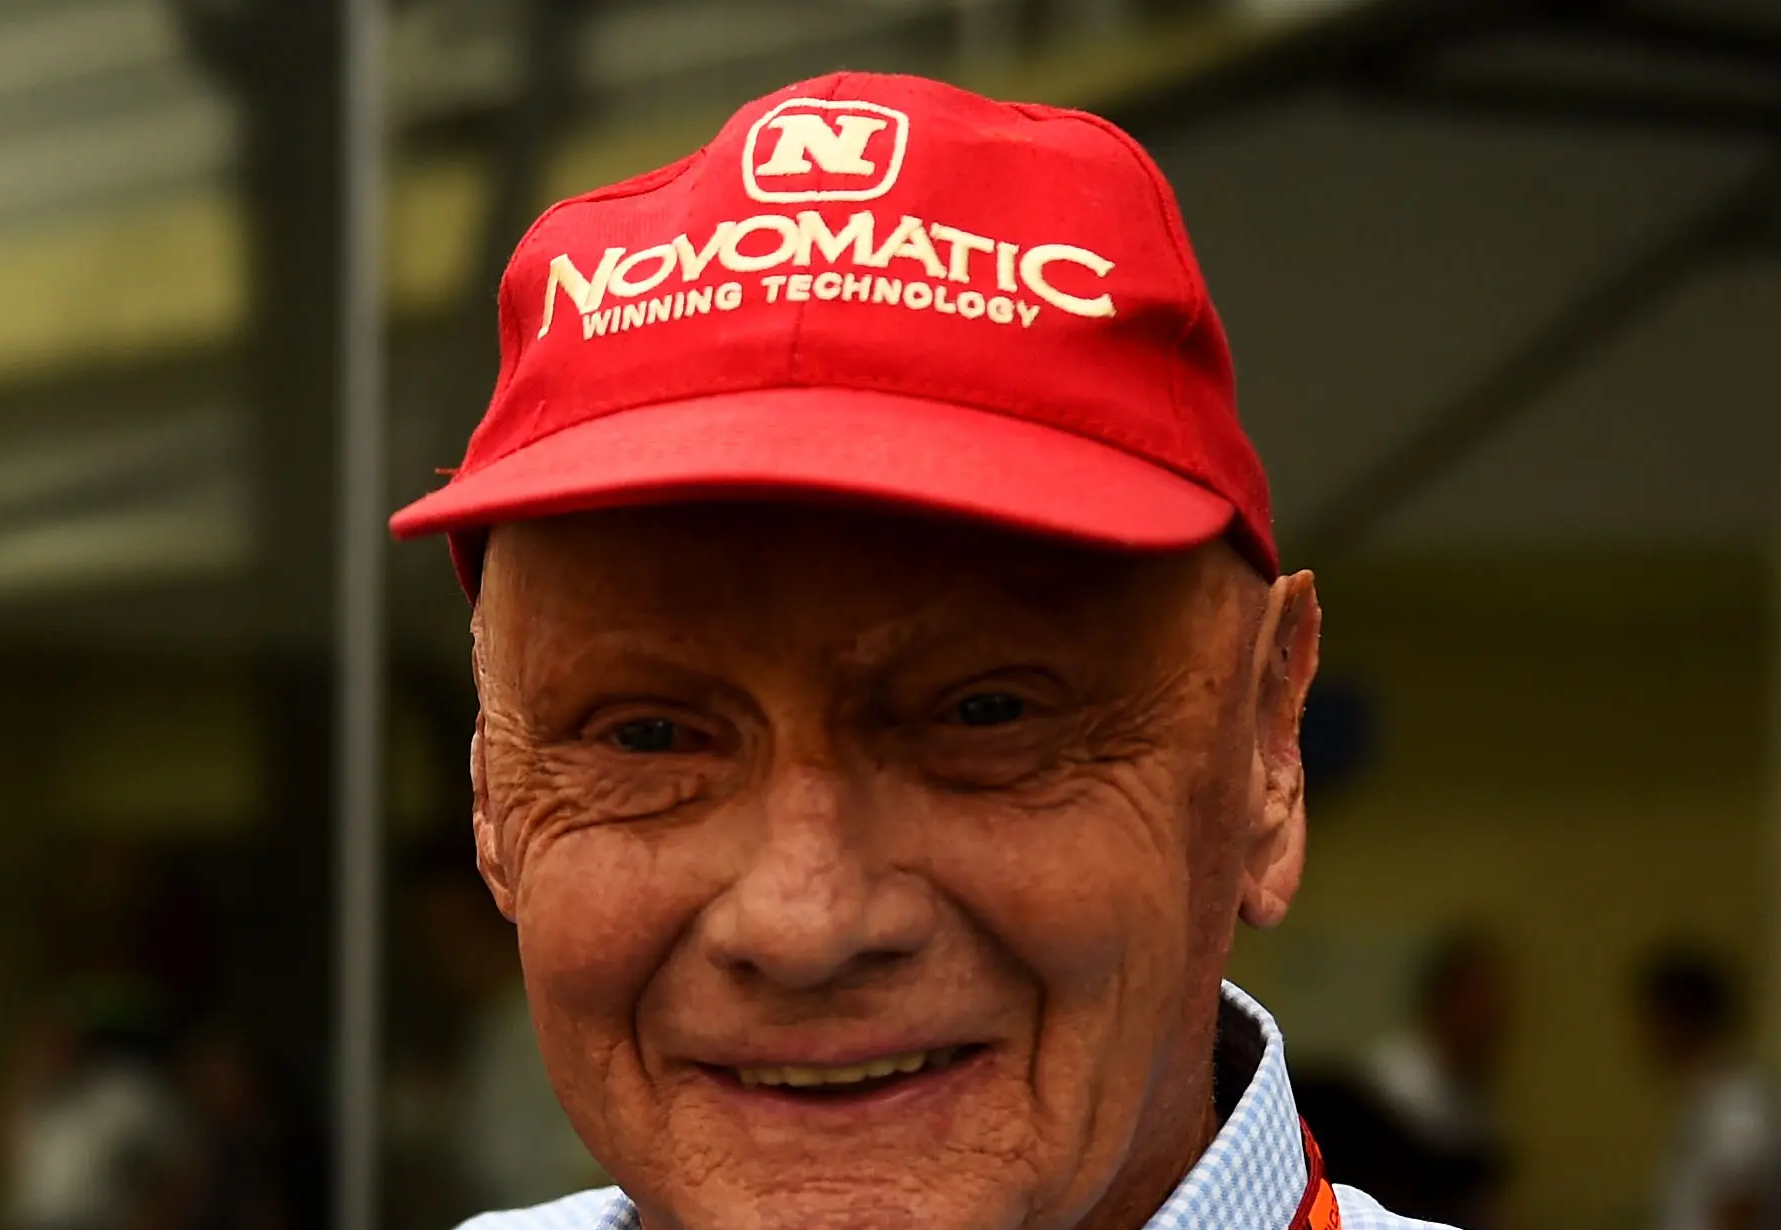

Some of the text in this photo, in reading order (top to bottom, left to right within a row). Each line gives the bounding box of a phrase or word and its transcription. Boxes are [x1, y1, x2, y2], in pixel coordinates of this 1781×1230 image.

[755, 114, 888, 176] N
[538, 210, 1116, 339] NOVOMATIC
[582, 272, 1040, 340] WINNING TECHNOLOGY
